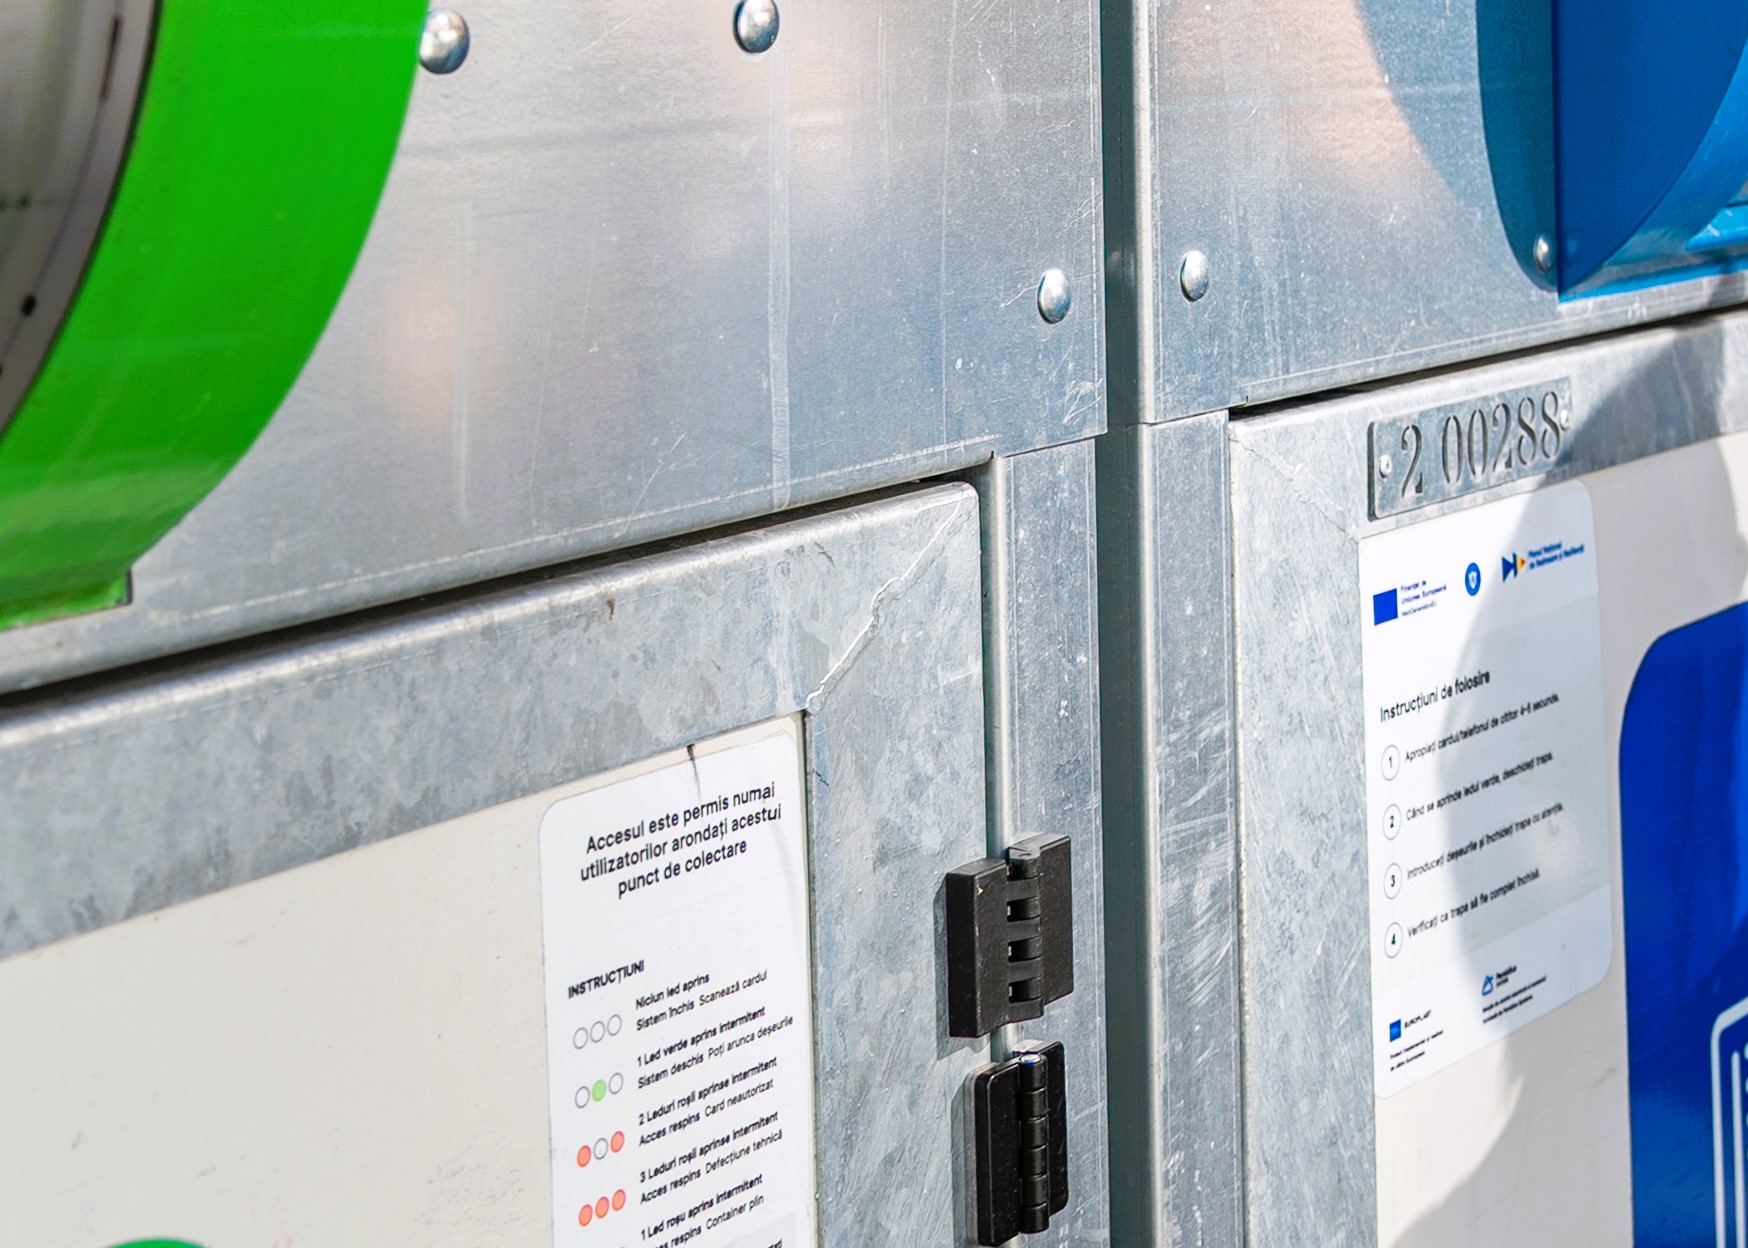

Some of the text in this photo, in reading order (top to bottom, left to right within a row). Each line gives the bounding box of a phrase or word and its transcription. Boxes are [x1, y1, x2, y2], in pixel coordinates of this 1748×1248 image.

[1401, 391, 1561, 498] 2 00288
[1380, 670, 1490, 722] Instrucțiuni de folosire
[1388, 756, 1393, 768] 1
[586, 781, 776, 854] Accesul este permis numai
[1390, 815, 1395, 829] 2
[1427, 803, 1434, 812] se
[580, 804, 782, 882] utilizatorilor arondați acestui
[618, 839, 748, 900] punct de colectare
[1391, 874, 1396, 887] 3
[1391, 933, 1396, 945] 4
[567, 959, 645, 1000] INSTRUCȚIUNI
[636, 973, 710, 1010] Niciun led aprins
[636, 969, 768, 1032] Sistem închis Scanează cardul
[637, 1006, 766, 1068] 1 Led verde aprins intermitent
[638, 1015, 794, 1089] Sistem deschis Poți arunca deșeurile
[638, 1057, 777, 1126] 2 Leduri roșii aprinse intermitent
[639, 1078, 774, 1147] Acces respins Card neautorizat
[639, 1111, 778, 1184] 3 Leduri roșii aprinse intermitent
[640, 1128, 784, 1205] Acces respins Defecțiune tehnică
[640, 1173, 763, 1241] 1 Led roșu aprins intermitent
[671, 1194, 765, 1248] respins Container plin
